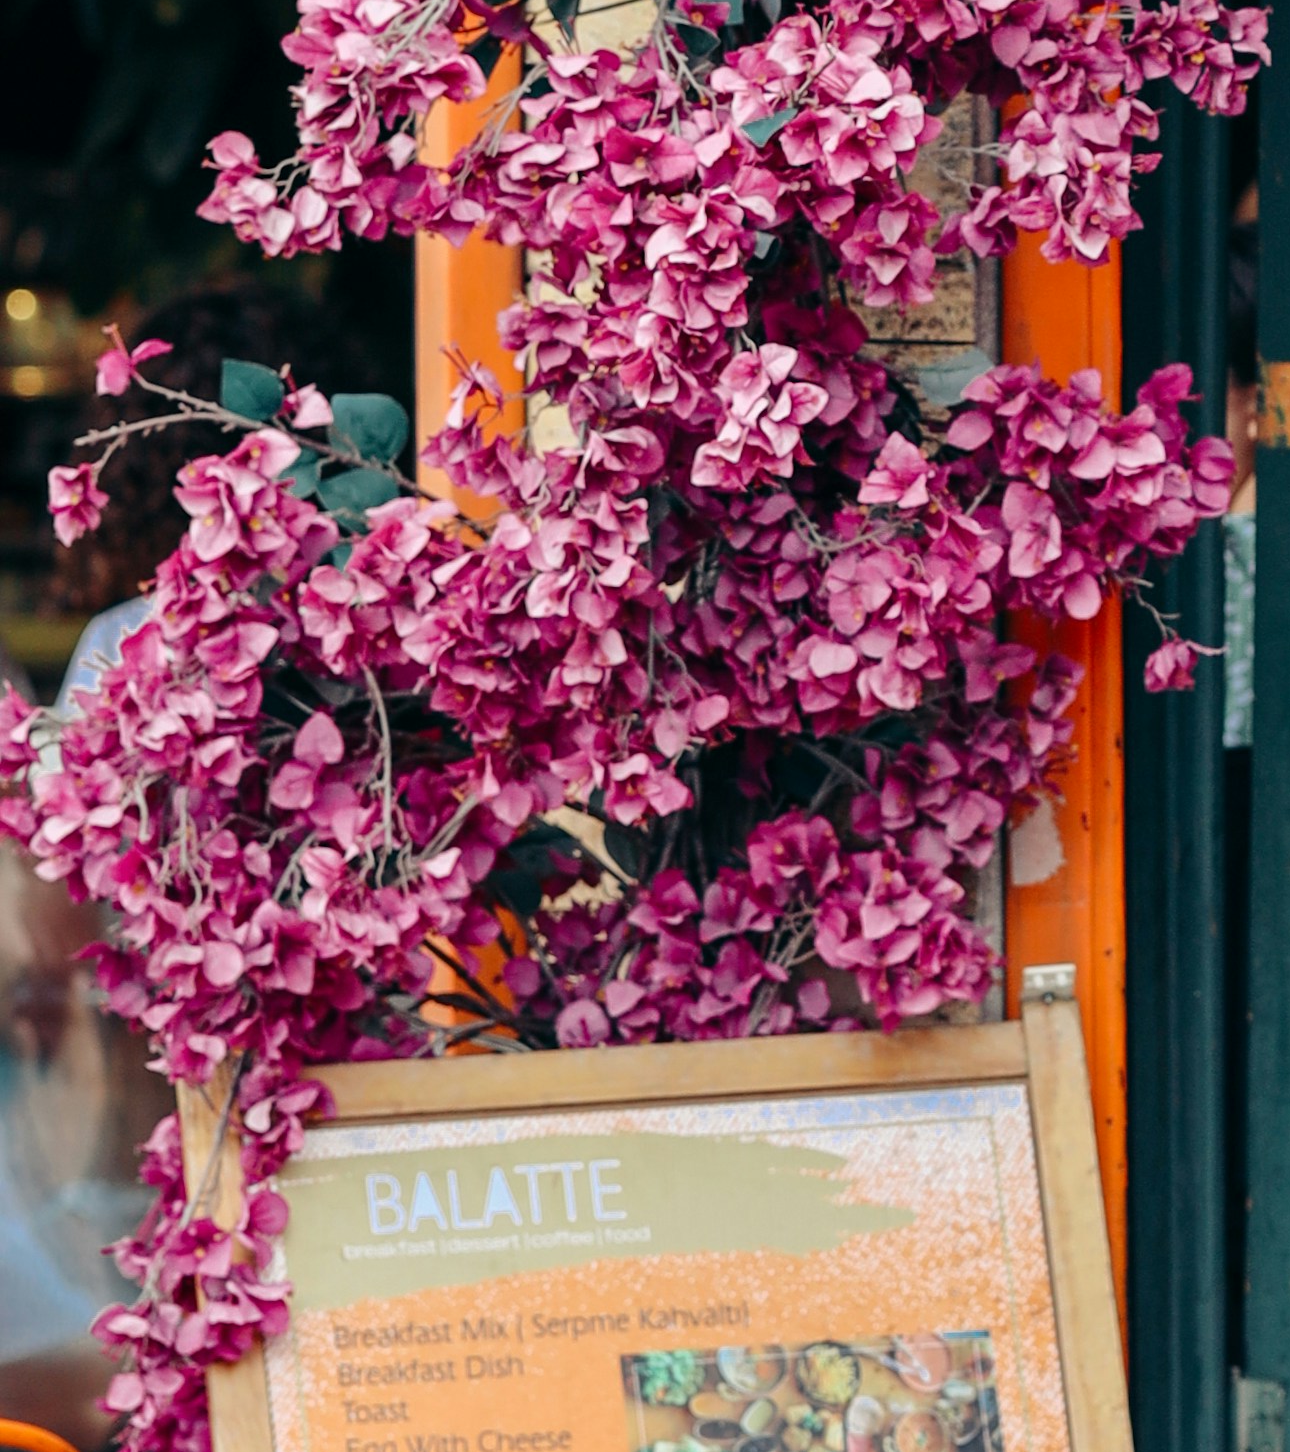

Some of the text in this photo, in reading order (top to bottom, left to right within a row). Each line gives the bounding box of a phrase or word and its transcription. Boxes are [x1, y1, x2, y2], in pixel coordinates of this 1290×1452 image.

[365, 1158, 628, 1235] BALATTE
[334, 1321, 453, 1350] Breakfast
[461, 1318, 507, 1341] Mix
[532, 1312, 629, 1341] Serpme
[337, 1353, 524, 1387] Breakfast Dish
[342, 1399, 410, 1425] Toast
[477, 1429, 573, 1452] Cheese
